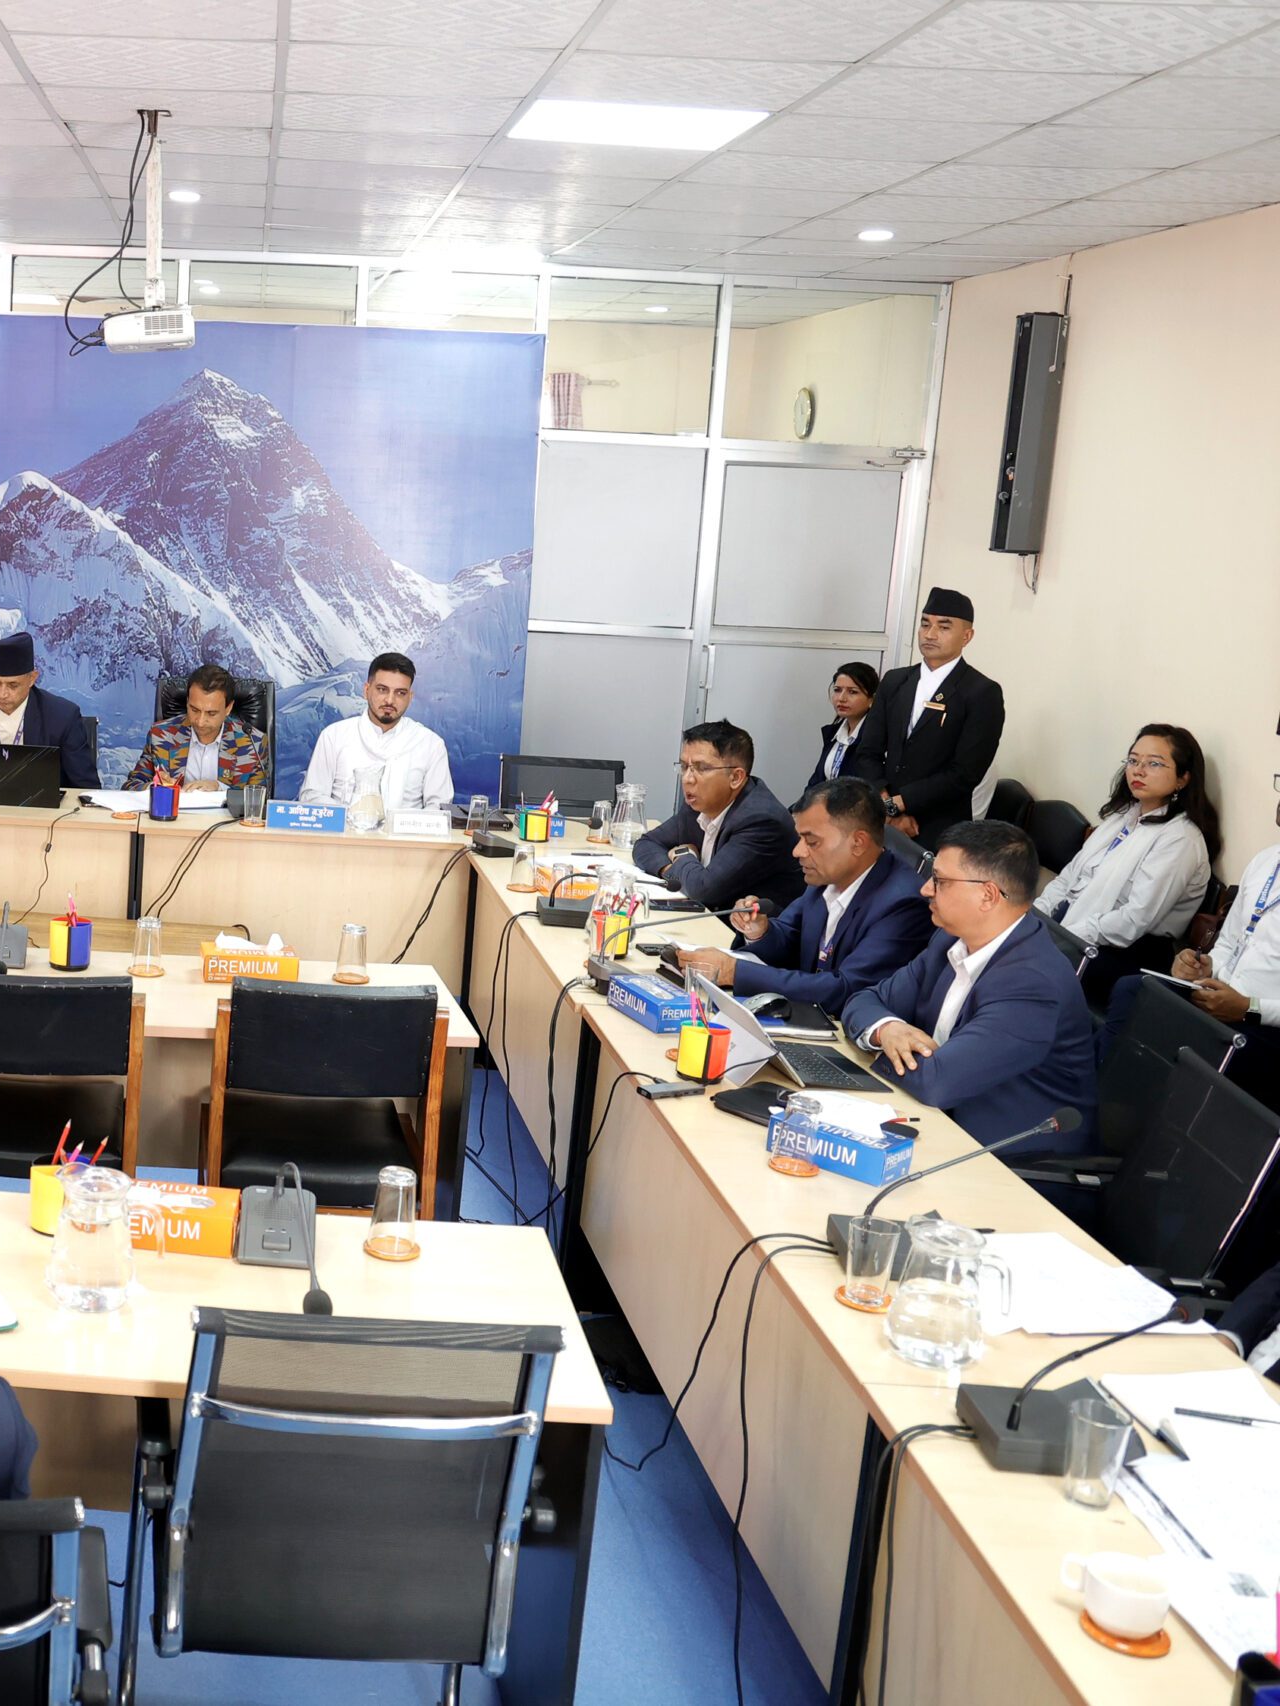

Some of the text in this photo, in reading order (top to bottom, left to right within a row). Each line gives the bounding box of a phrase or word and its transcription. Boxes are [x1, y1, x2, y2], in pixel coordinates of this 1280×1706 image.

[208, 960, 278, 975] PREMIUM
[609, 982, 647, 1015] PREMIUM
[772, 1125, 857, 1166] PREMIUM
[129, 1215, 200, 1240] EMIUM
